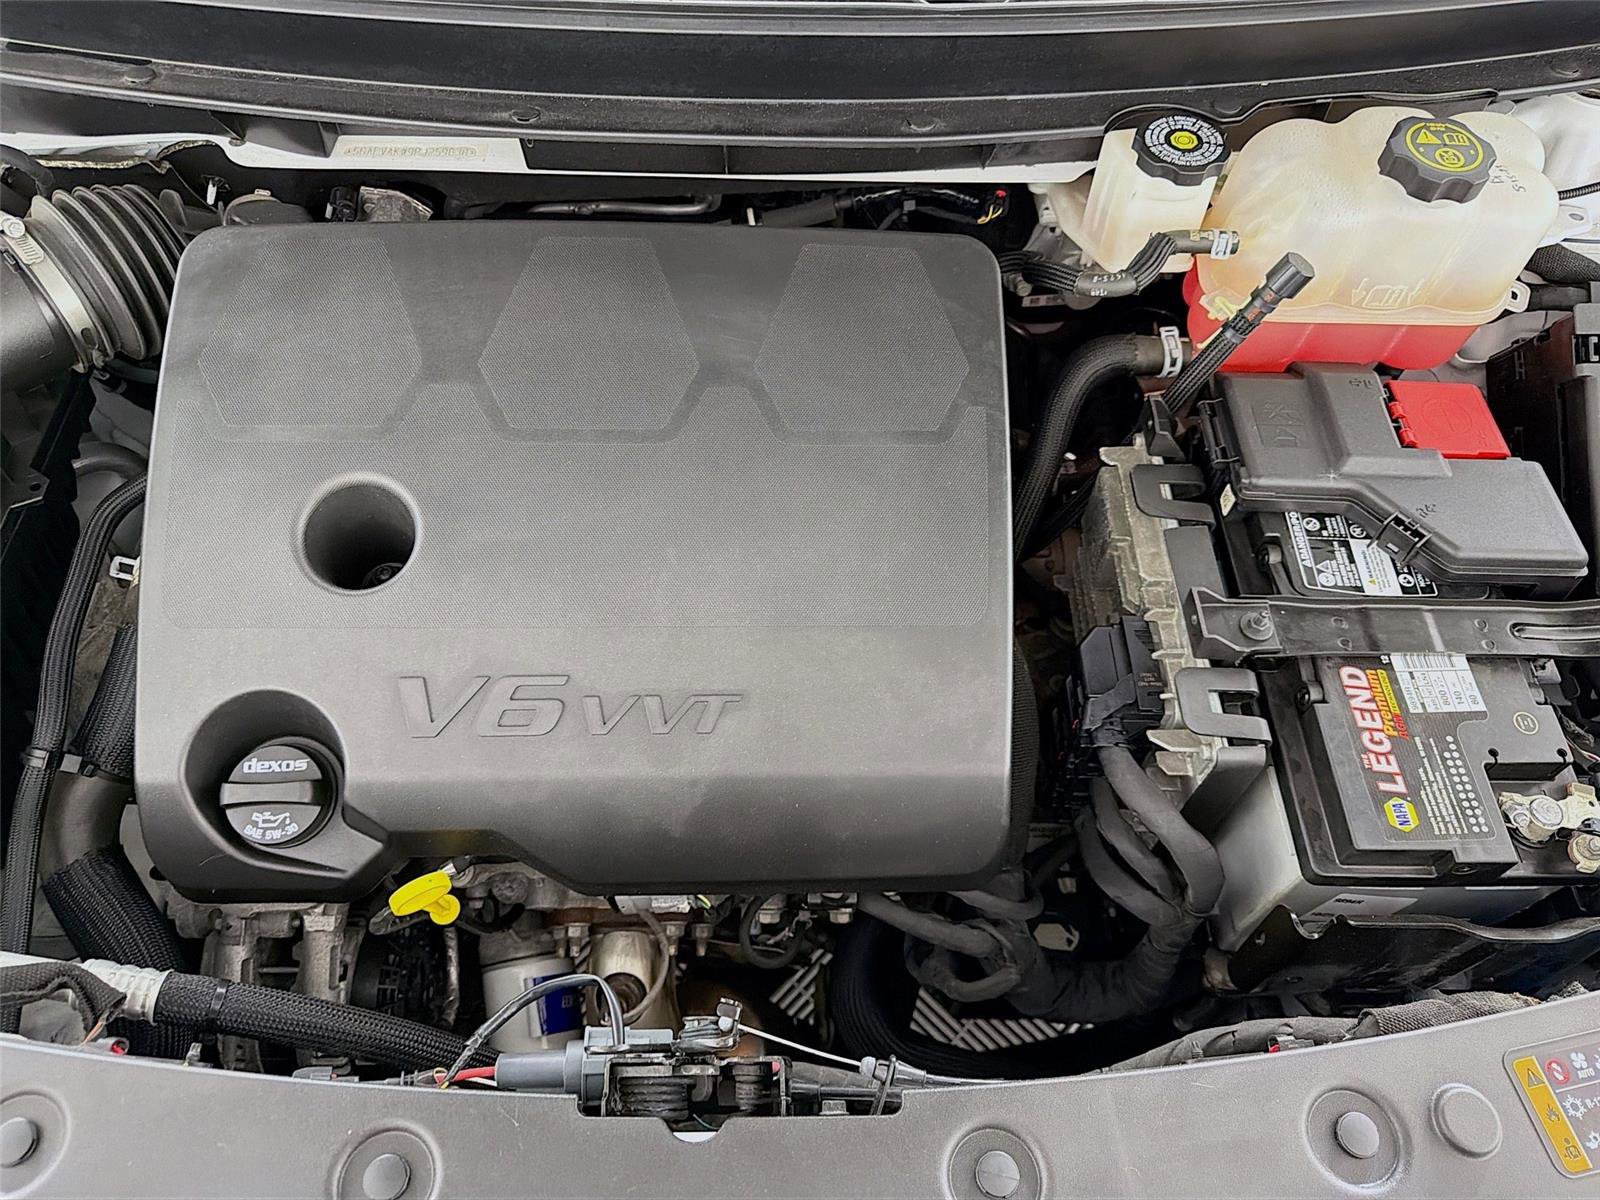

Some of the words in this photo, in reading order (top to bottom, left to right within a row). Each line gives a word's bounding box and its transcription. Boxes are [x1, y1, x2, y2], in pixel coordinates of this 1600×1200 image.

[400, 674, 570, 738] V6
[583, 694, 744, 736] VVT
[1365, 669, 1398, 737] Premium
[1339, 666, 1409, 795] LEGEND
[1392, 712, 1409, 740] AGM
[243, 758, 311, 773] dexos
[1392, 803, 1411, 826] NAPA
[243, 824, 263, 839] SAE
[265, 822, 299, 840] 5W-30
